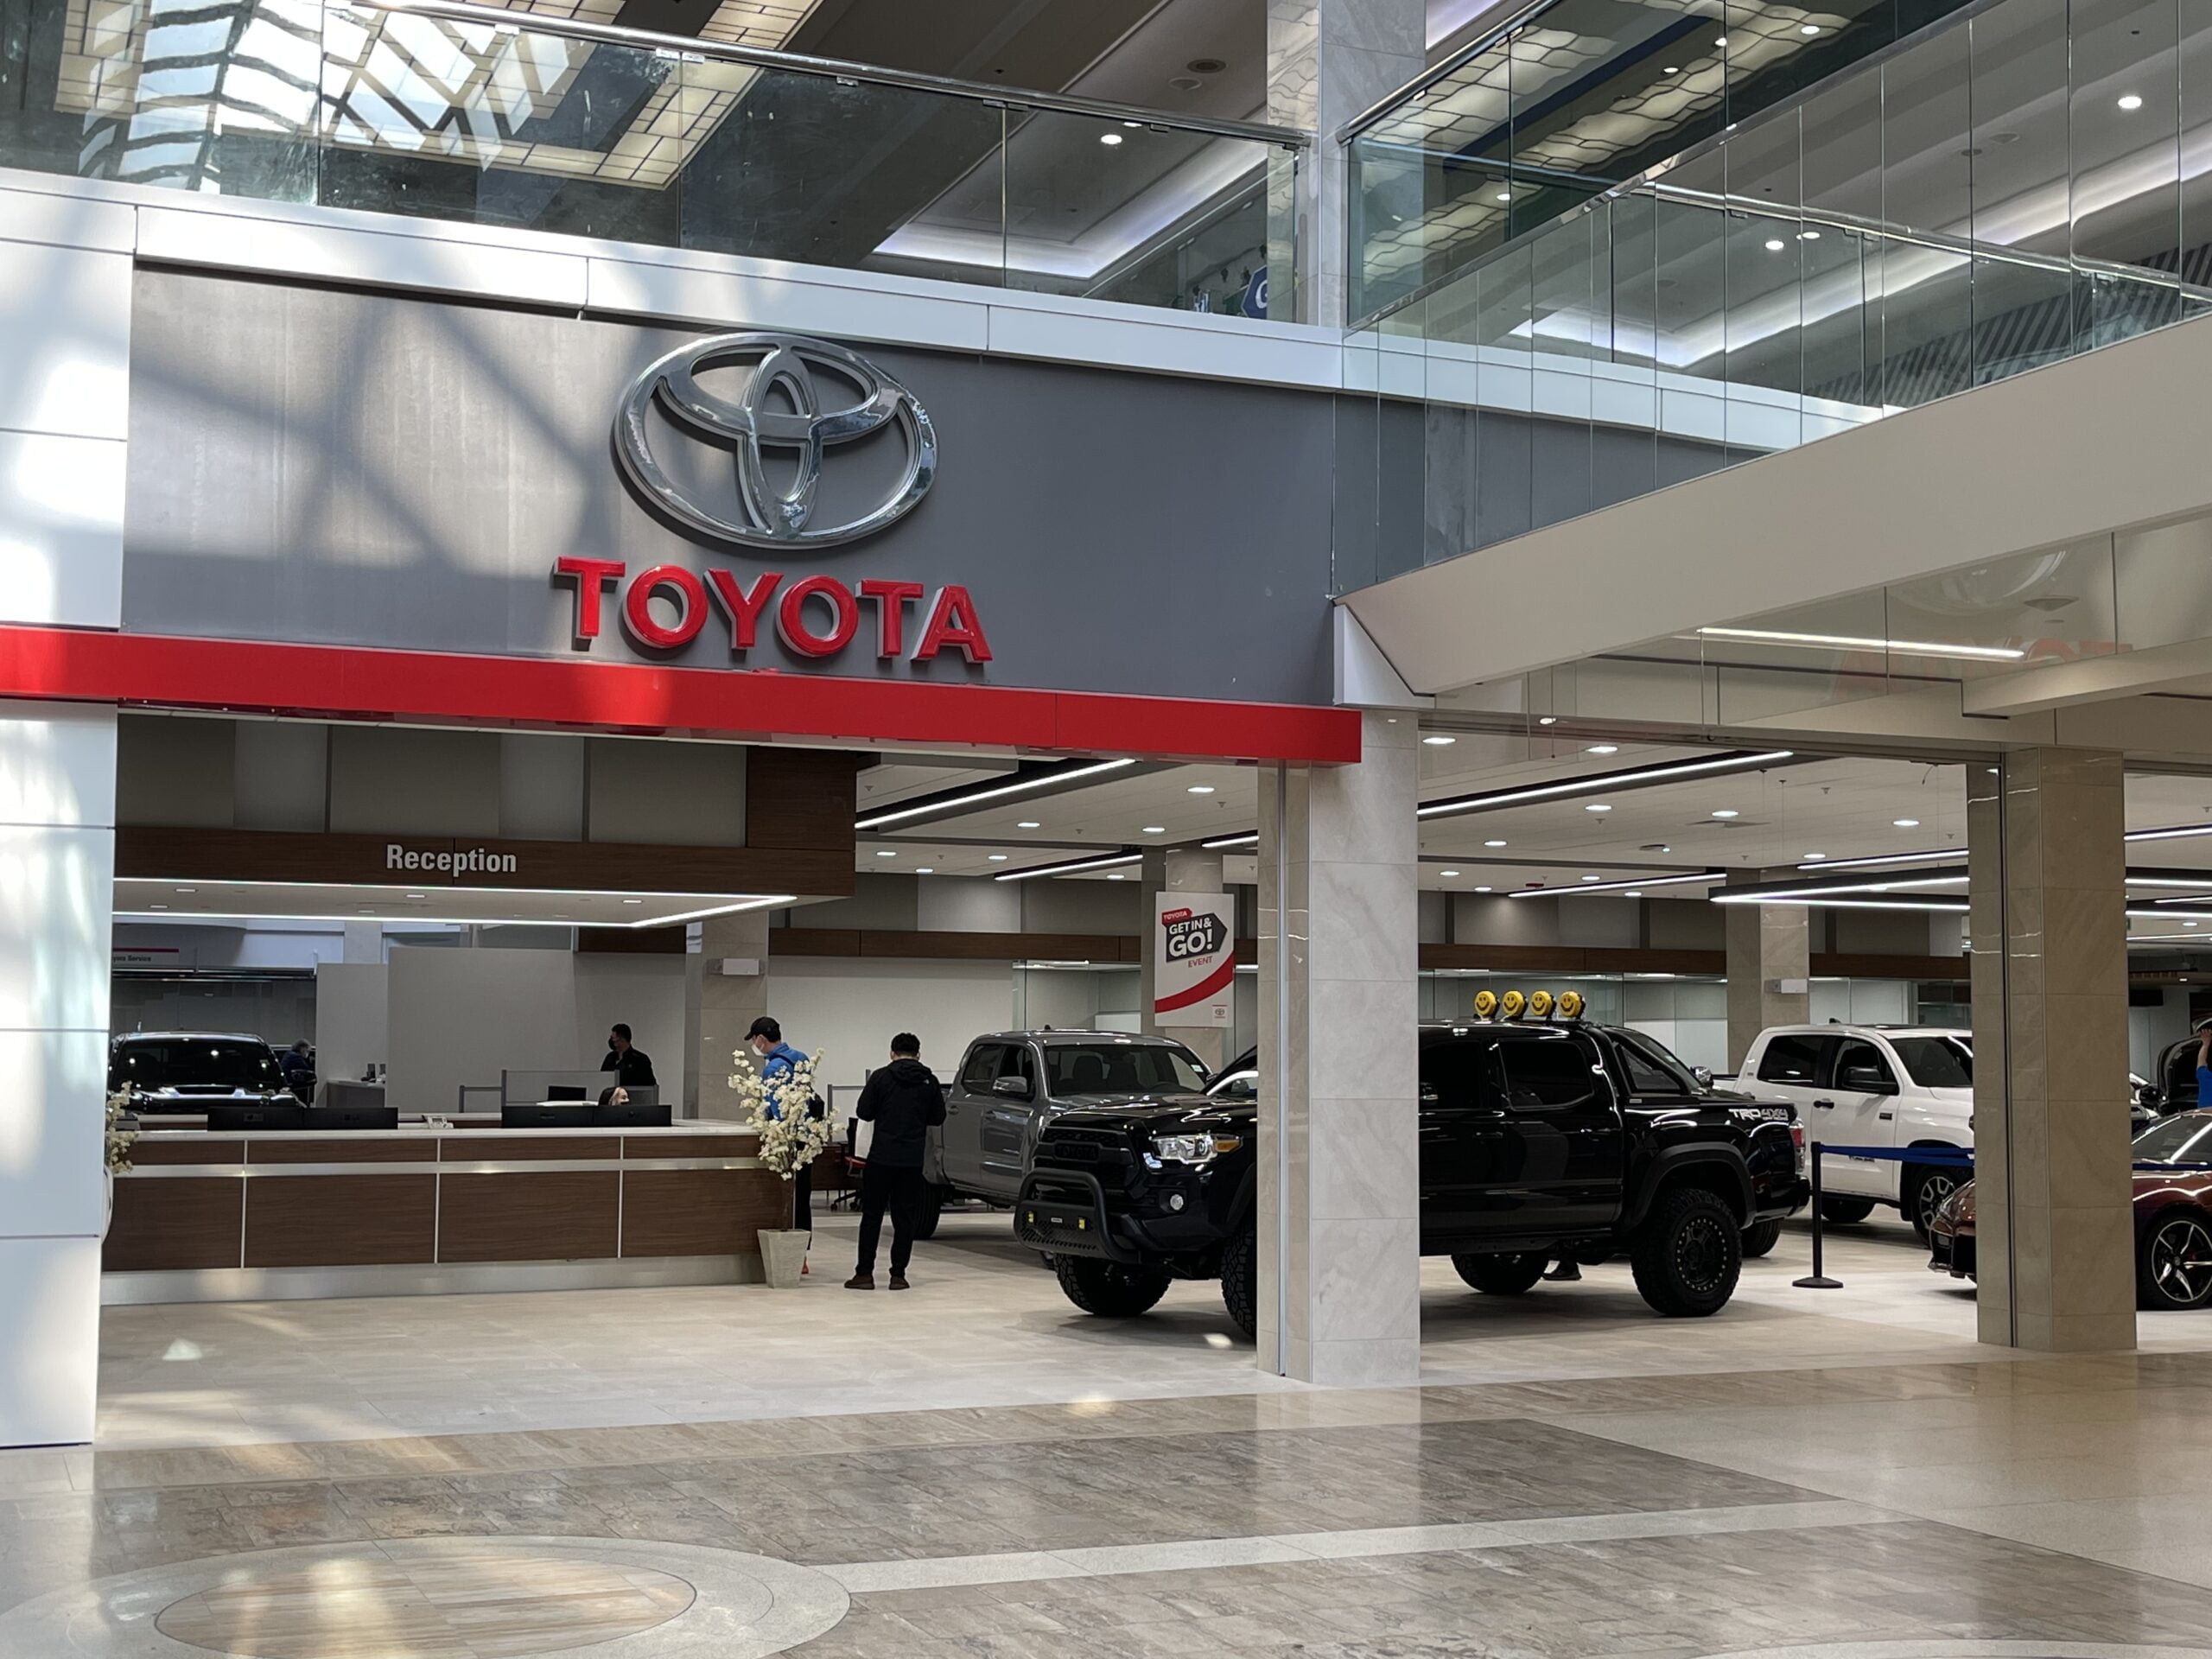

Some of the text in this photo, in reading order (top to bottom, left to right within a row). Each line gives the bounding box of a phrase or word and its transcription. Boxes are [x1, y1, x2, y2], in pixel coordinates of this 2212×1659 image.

[553, 556, 993, 664] TOYOTA
[386, 844, 517, 878] Reception
[1163, 910, 1188, 921] TOYOTA
[1169, 917, 1212, 936] GET IN &
[1168, 929, 1213, 957] GO!
[1188, 956, 1213, 968] EVENT
